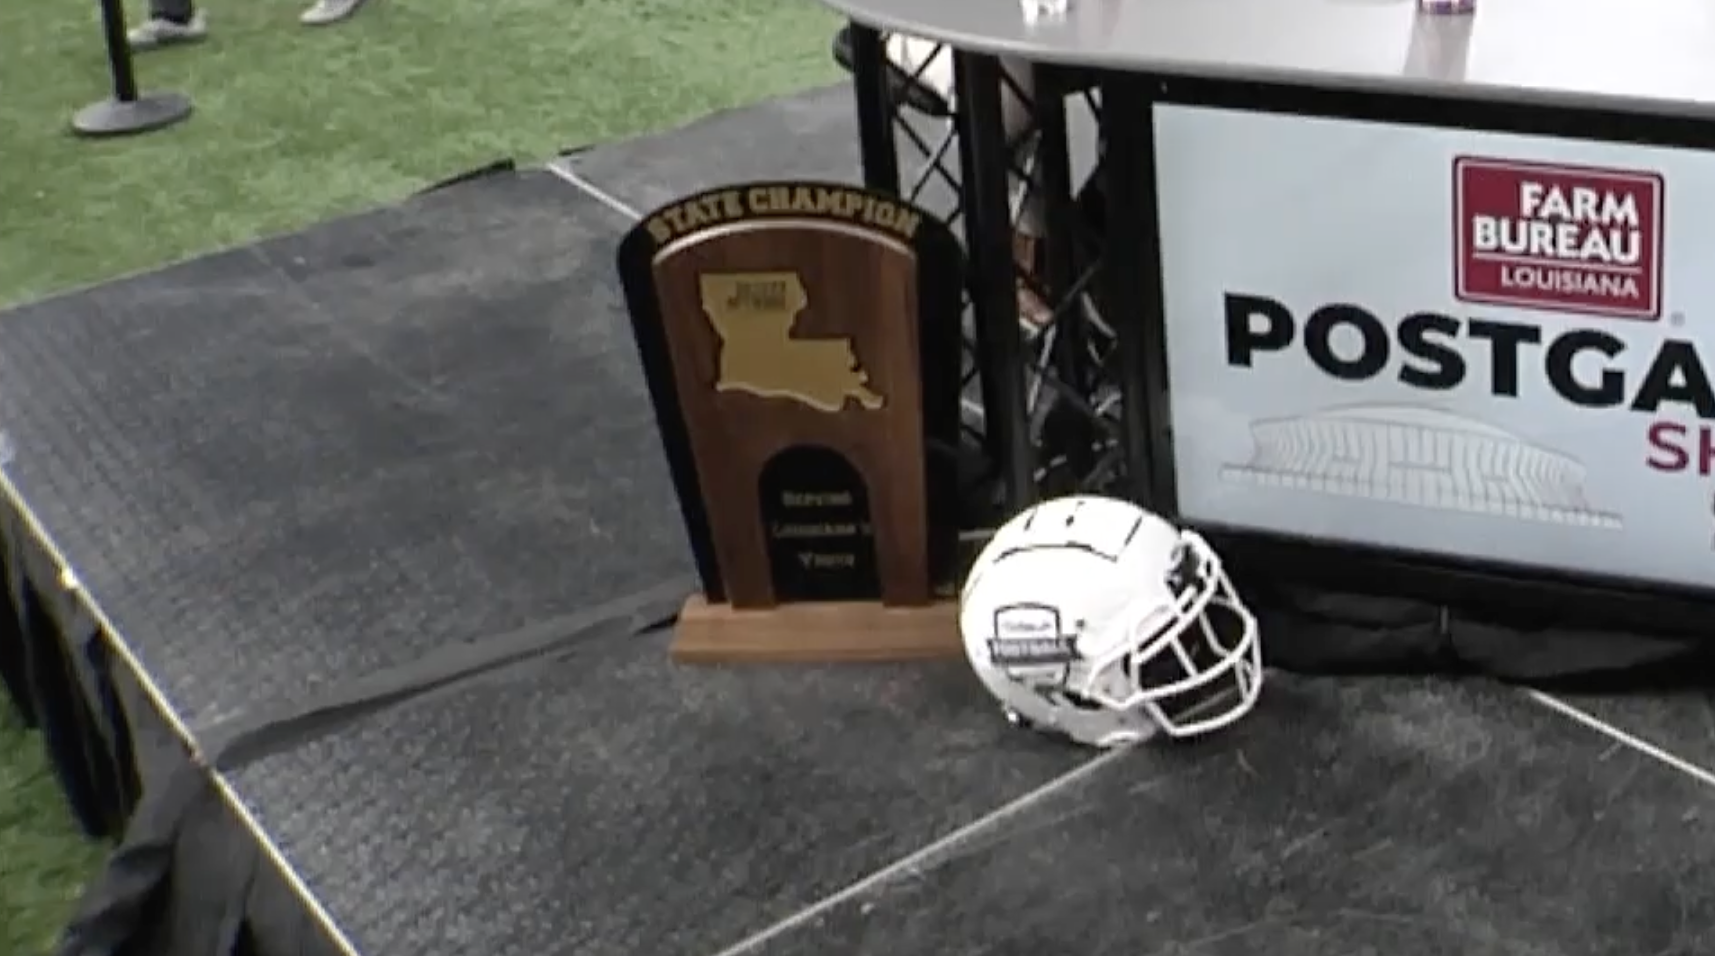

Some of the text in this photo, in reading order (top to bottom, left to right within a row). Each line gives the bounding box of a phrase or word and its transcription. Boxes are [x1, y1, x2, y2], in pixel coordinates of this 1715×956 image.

[647, 186, 920, 244] STATE CHAMPION
[1521, 180, 1638, 226] FARM
[1473, 214, 1641, 264] BUREAU
[1501, 265, 1639, 299] LOUISIANA
